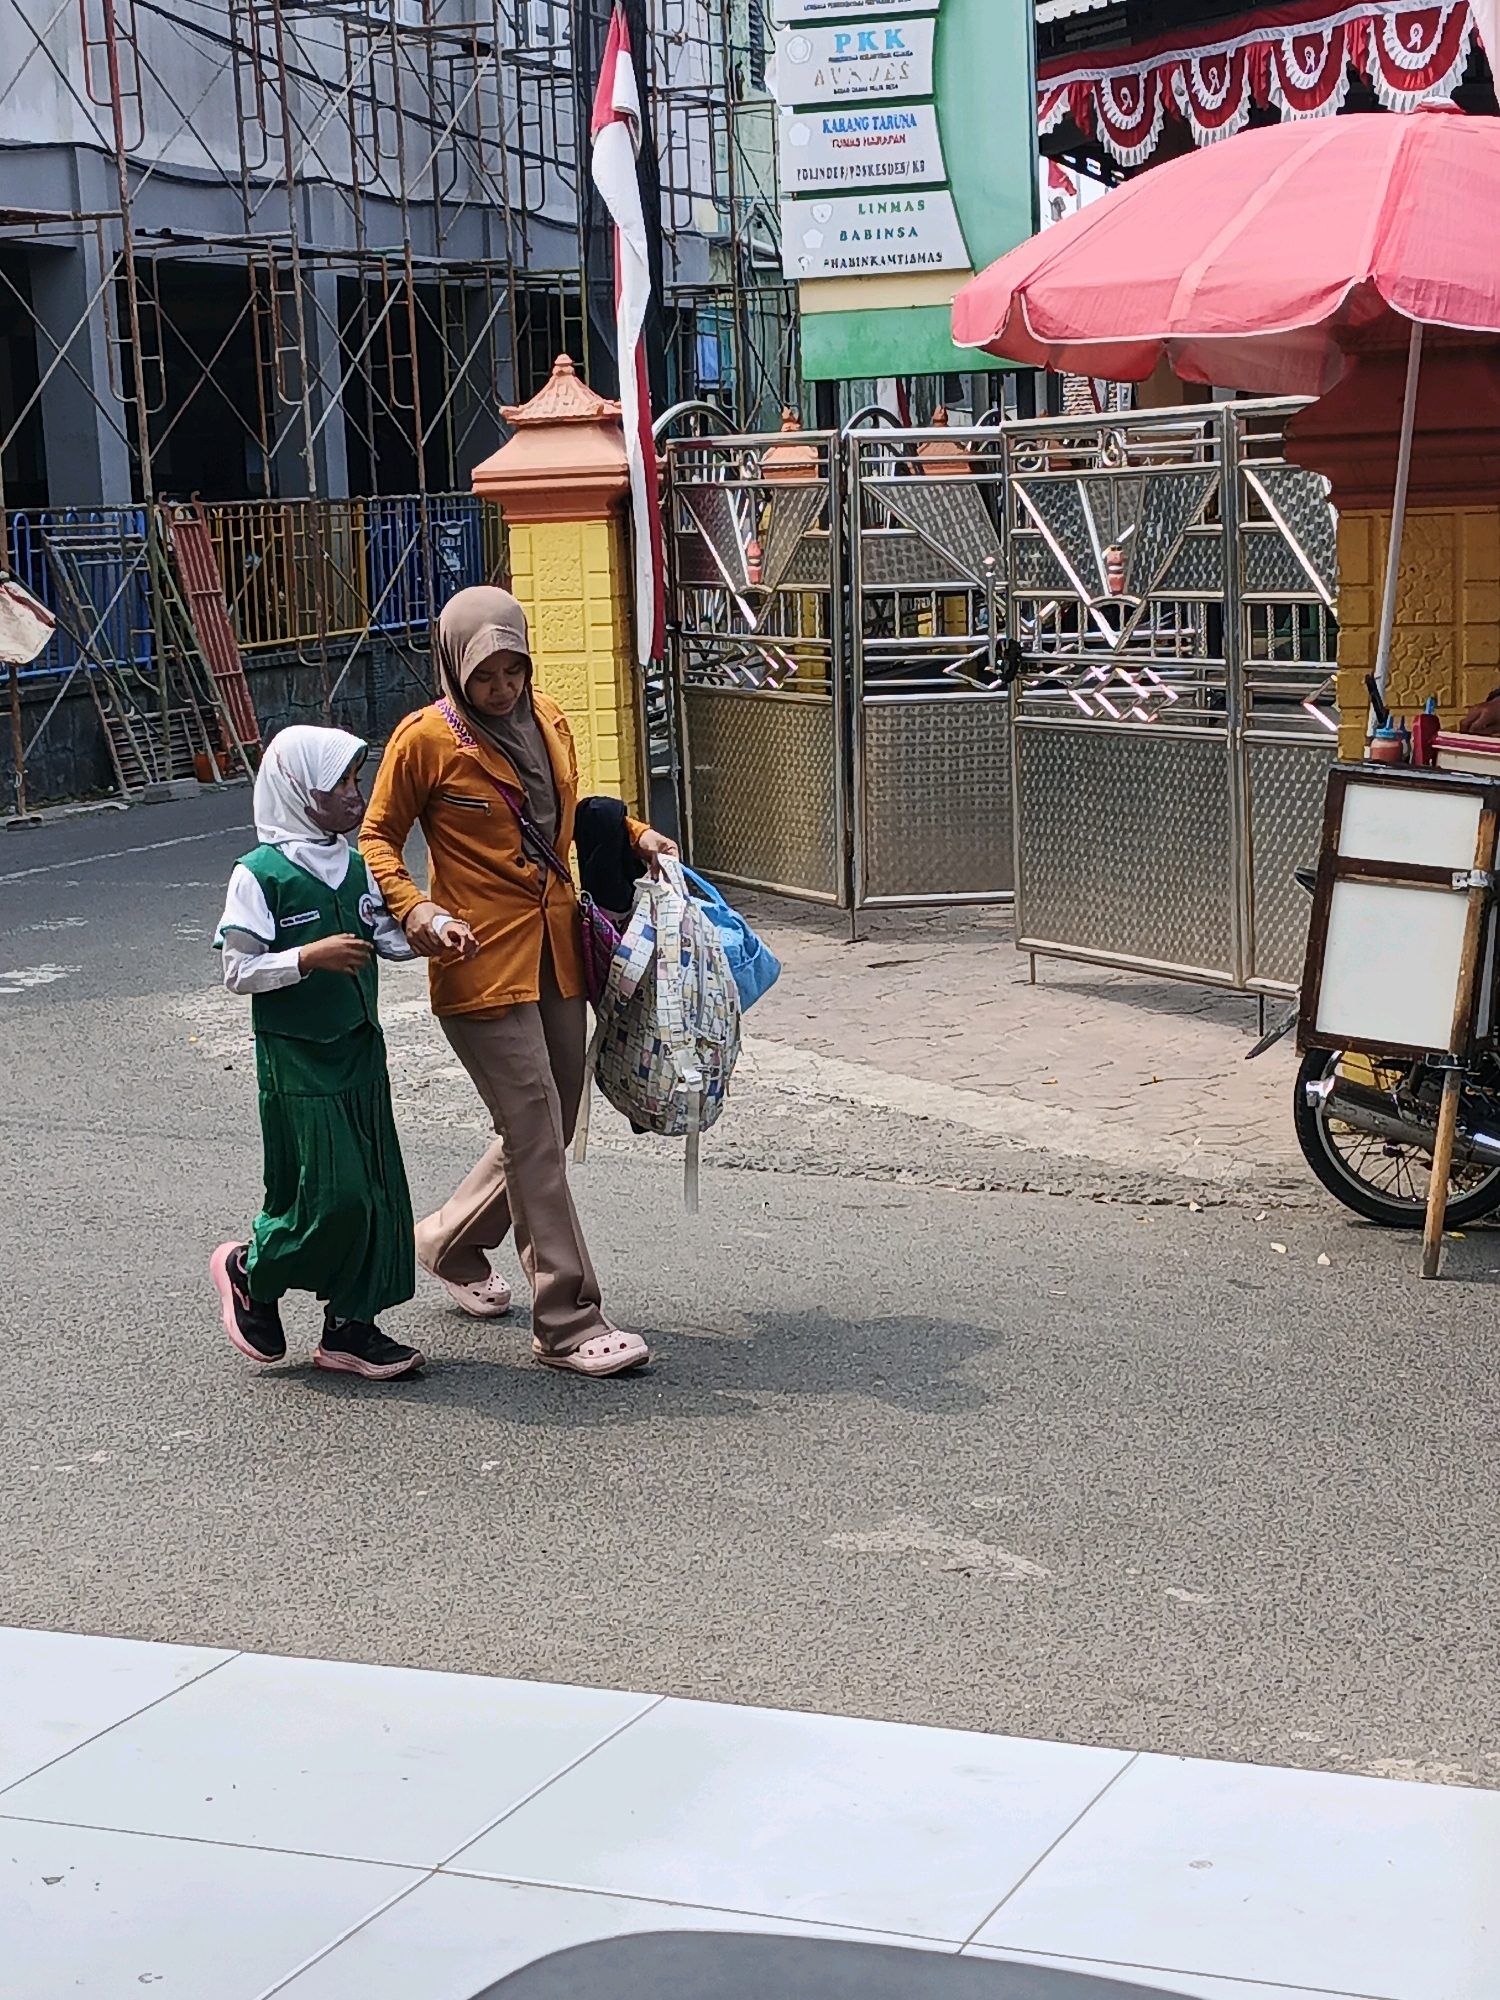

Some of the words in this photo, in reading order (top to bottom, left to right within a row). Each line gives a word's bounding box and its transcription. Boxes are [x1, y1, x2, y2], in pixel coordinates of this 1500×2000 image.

[834, 28, 906, 54] PKK
[858, 199, 926, 216] LINMAS
[839, 226, 919, 242] BABINSA
